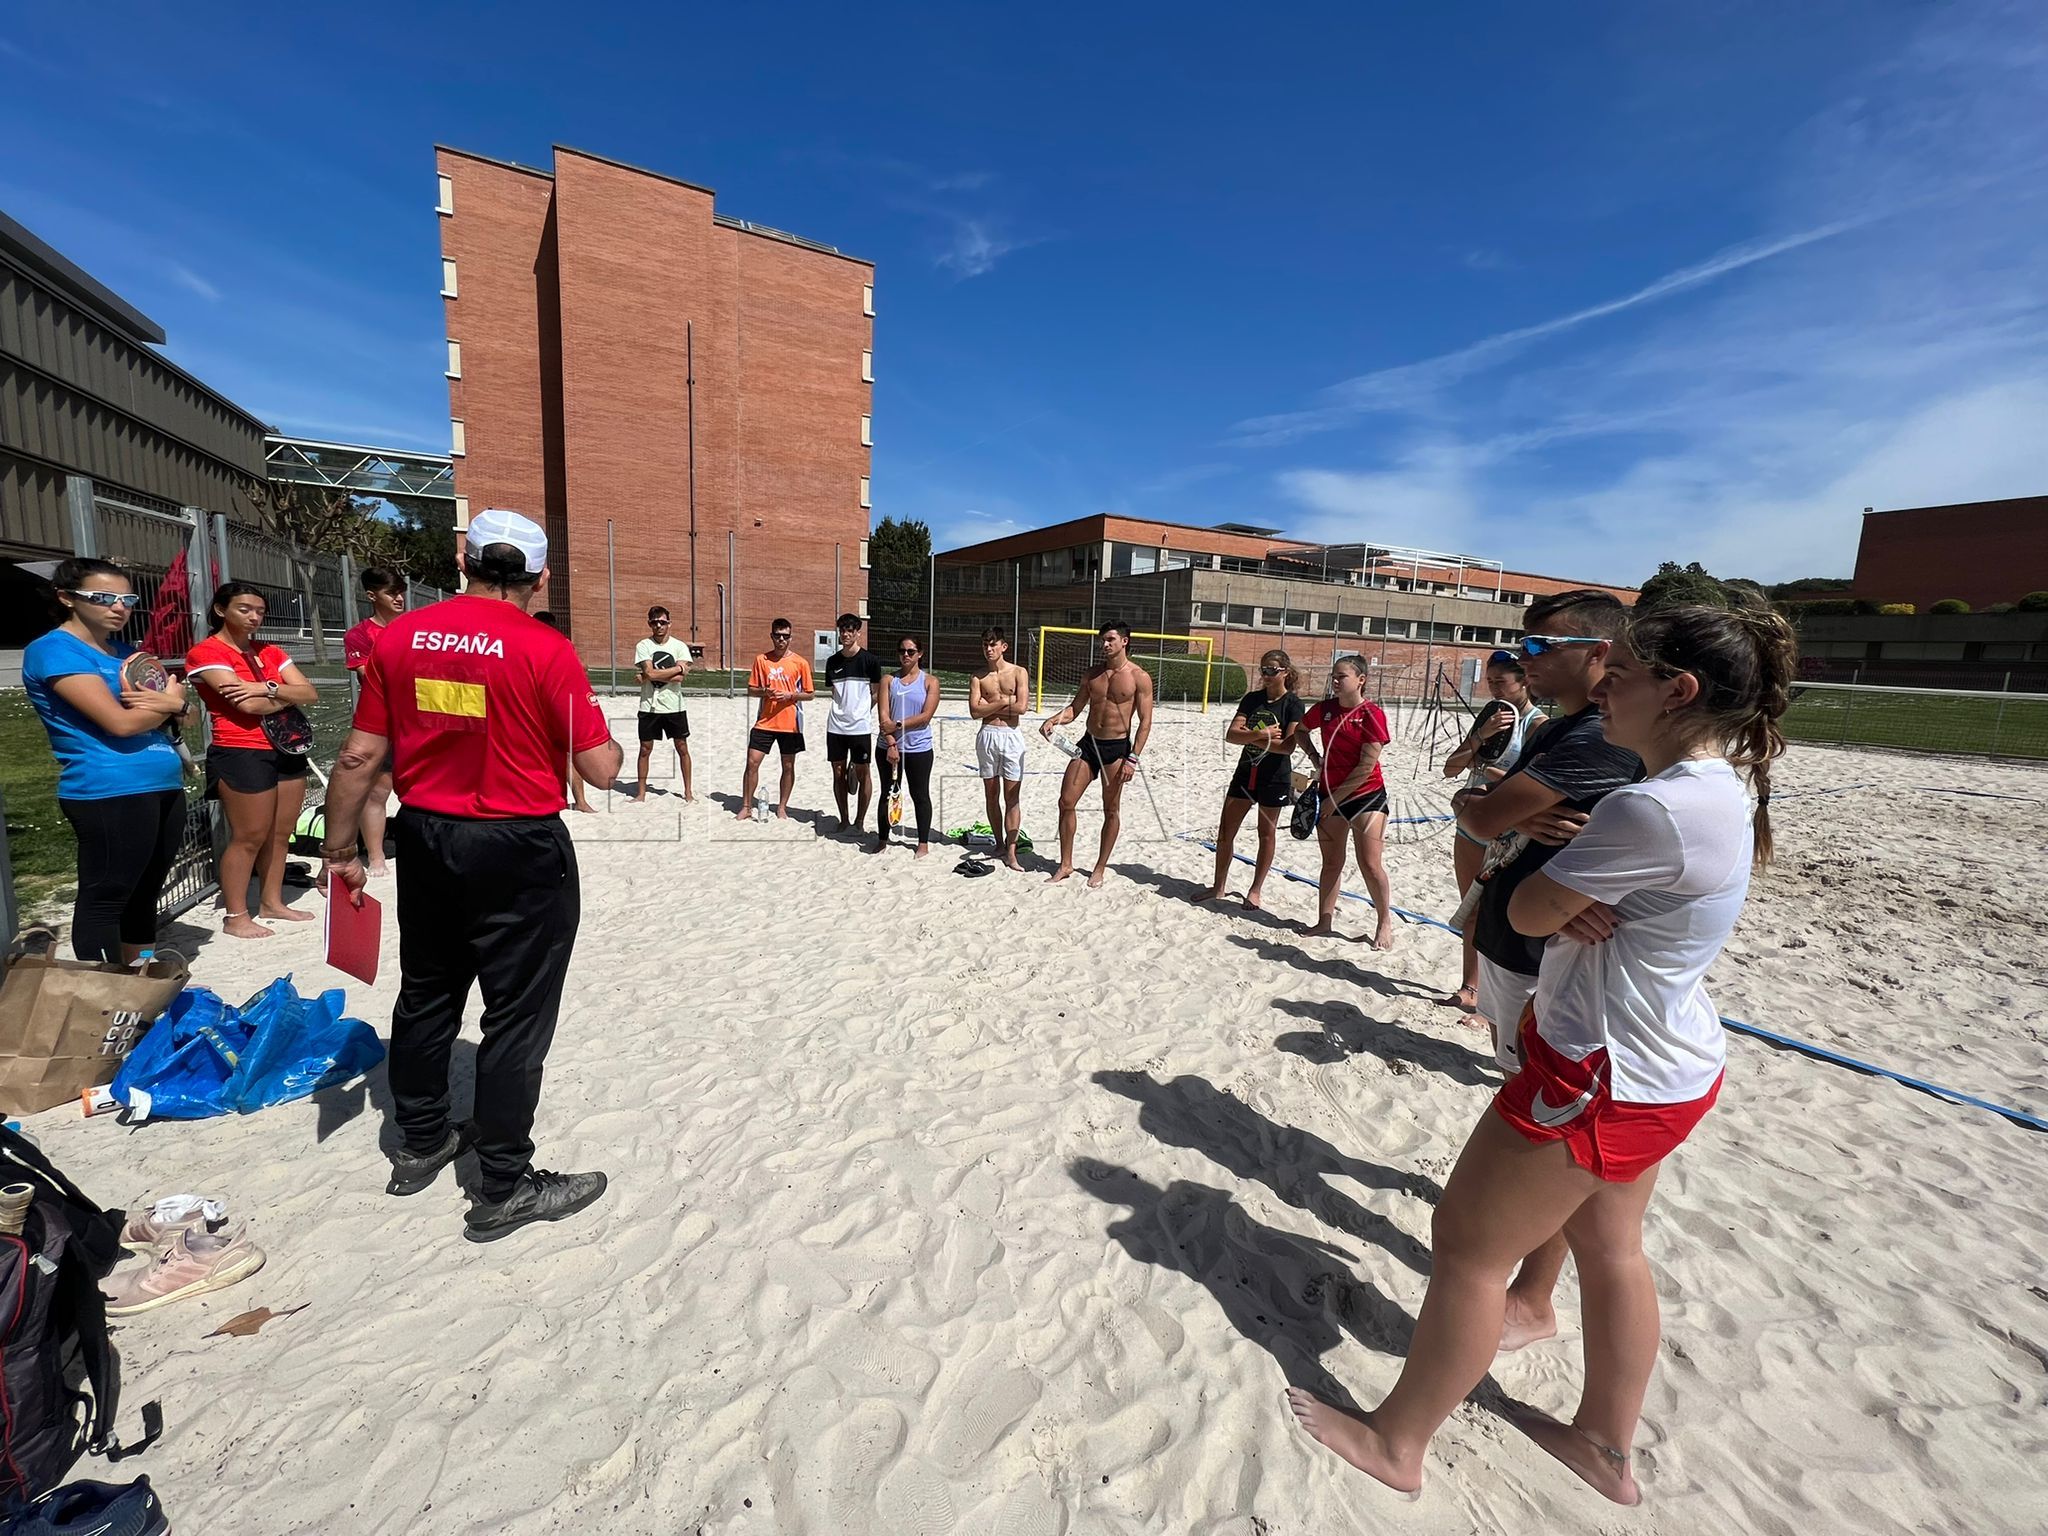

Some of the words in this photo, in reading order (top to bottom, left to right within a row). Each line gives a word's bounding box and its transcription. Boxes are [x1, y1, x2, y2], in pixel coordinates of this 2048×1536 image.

[411, 631, 504, 658] ESPAÑA
[113, 1010, 142, 1026] UN
[106, 1026, 135, 1041] CO
[101, 1041, 128, 1056] TO
